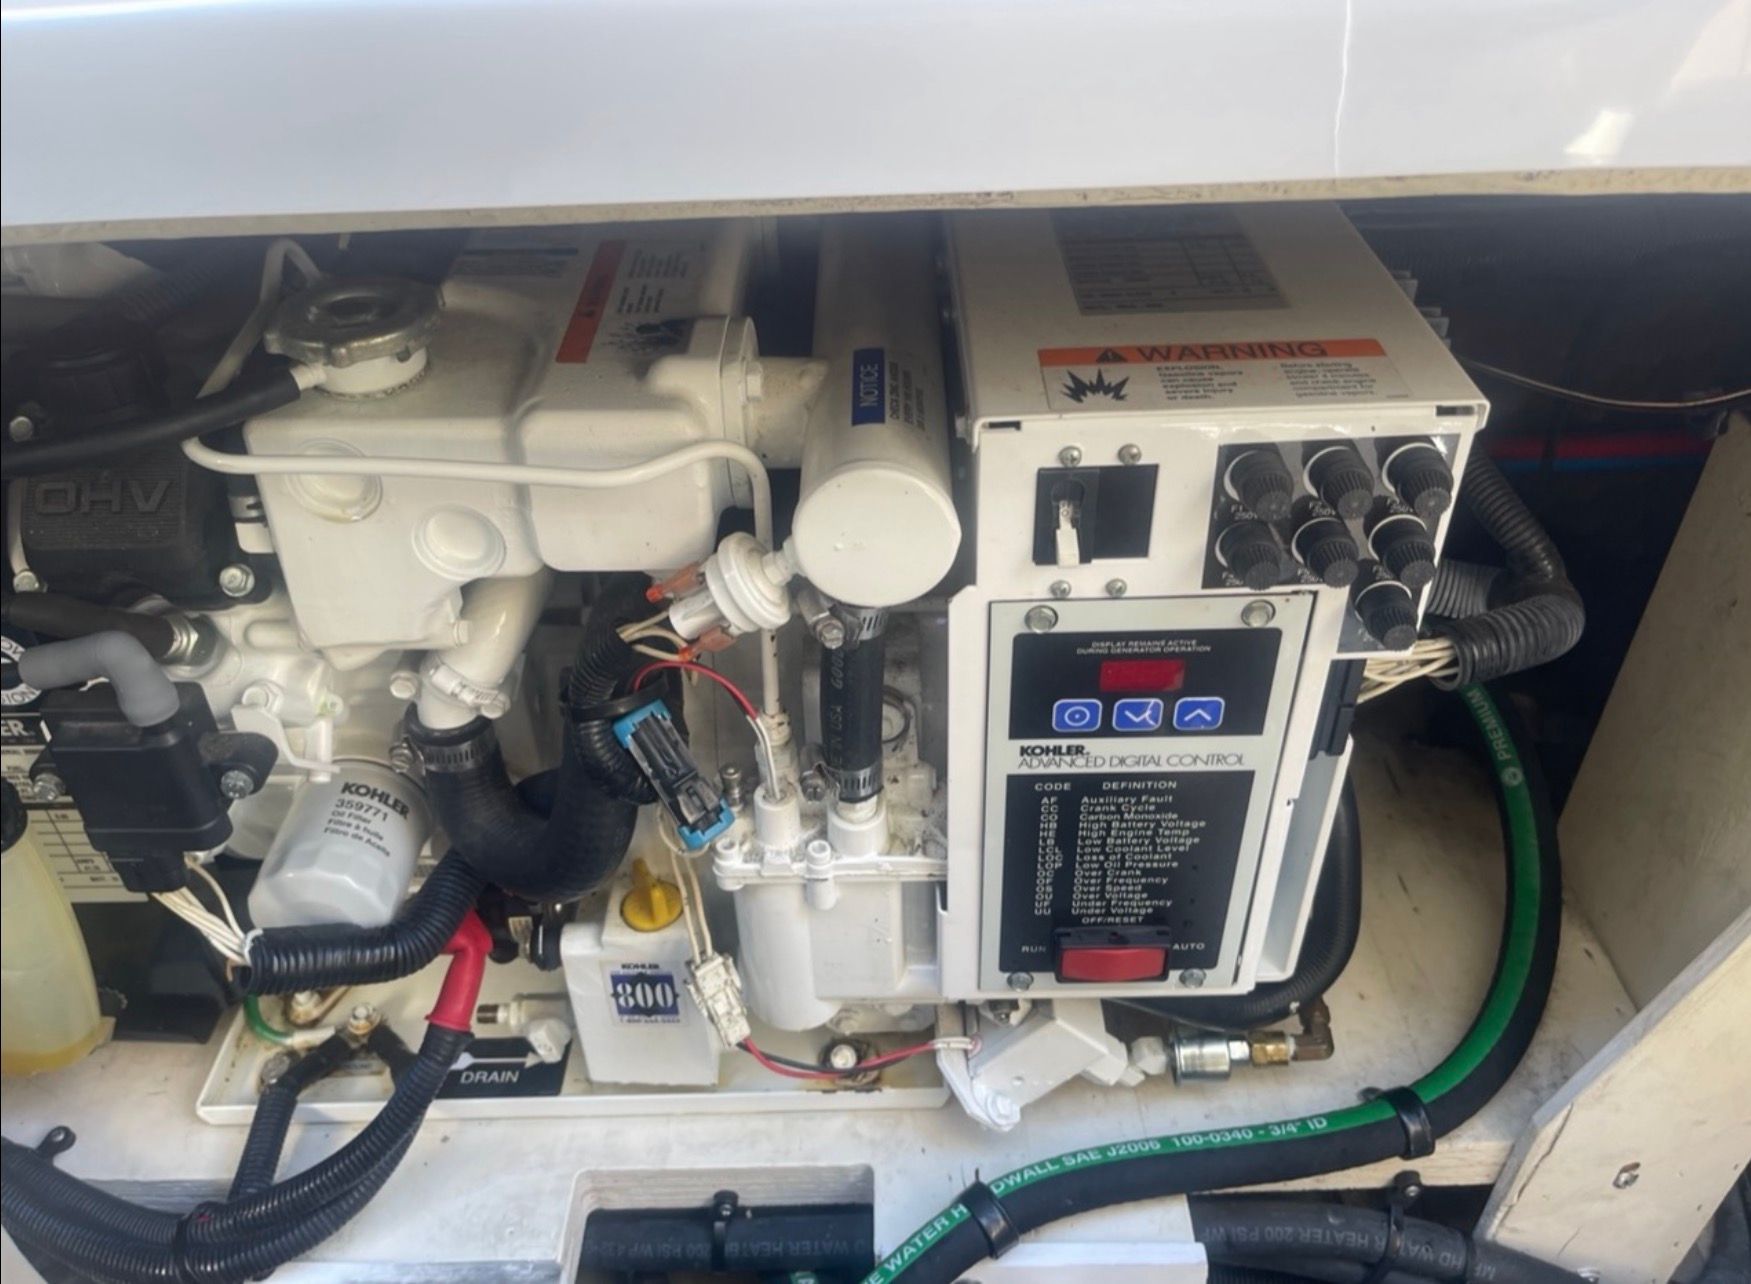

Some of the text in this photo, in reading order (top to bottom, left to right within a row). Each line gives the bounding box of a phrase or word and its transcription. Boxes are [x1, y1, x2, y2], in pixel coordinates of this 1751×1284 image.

[1138, 340, 1328, 361] WARNING
[859, 363, 879, 407] NOTICE
[34, 480, 172, 513] OHV
[1076, 645, 1212, 655] DURING GENERATOR OPERATION
[1467, 688, 1511, 760] PREMIUM
[1018, 752, 1245, 769] ADVANCED DIGITAL CONTROL
[1034, 781, 1177, 791] CODE DEFINITION
[341, 782, 410, 820] KOHLER
[1081, 795, 1137, 804] Auxiliary
[1141, 795, 1173, 803] Fault
[335, 798, 388, 822] 359771
[1080, 804, 1116, 812] Crank
[1121, 804, 1156, 813] Cycle
[347, 812, 372, 825] Filter
[1080, 813, 1121, 821] Carbon
[1124, 812, 1178, 820] Monoxide
[328, 818, 353, 828] Filtre
[1079, 821, 1107, 830] High
[1111, 820, 1156, 829] Battery
[1160, 820, 1206, 828] Voltage
[324, 827, 349, 837] Filtro
[351, 832, 364, 841] de
[1078, 830, 1106, 838] High
[1110, 829, 1153, 838] Engine
[1157, 828, 1190, 837] Temp
[1077, 837, 1101, 845] Low
[1106, 837, 1150, 846] Battery
[1155, 836, 1200, 845] Voltage
[1105, 845, 1152, 853] Coolant
[1157, 844, 1190, 852] Level
[1109, 853, 1121, 861] of
[1125, 852, 1172, 861] Coolant
[1104, 861, 1120, 869] Oil
[1125, 860, 1179, 868] Pressure
[1075, 869, 1102, 877] Over
[1107, 868, 1142, 877] Crank
[1074, 877, 1101, 885] Over
[1106, 876, 1168, 885] Frequency
[1105, 884, 1142, 893] Speed
[1072, 892, 1100, 900] Over
[1104, 891, 1148, 900] Voltage
[1072, 900, 1107, 908] Under
[1111, 899, 1173, 908] Frequency
[1071, 907, 1106, 915] Under
[1110, 906, 1153, 915] Voltage
[1081, 915, 1145, 924] OFF/RESET
[1021, 942, 1205, 953] RUN AUTO
[616, 982, 675, 1009] 800
[460, 1070, 519, 1084] DRAIN
[884, 1215, 950, 1272] WATER
[1061, 1147, 1102, 1167] SAE
[1106, 1137, 1162, 1158] J2006
[1171, 1127, 1254, 1149] 100-0340
[1306, 1116, 1328, 1131] ID
[1231, 1225, 1261, 1242] PSI
[1264, 1225, 1295, 1242] 200
[1300, 1227, 1370, 1249] HEATER
[656, 1243, 682, 1259] PSI
[788, 1238, 850, 1258] WATER
[1437, 1251, 1465, 1272] HD
